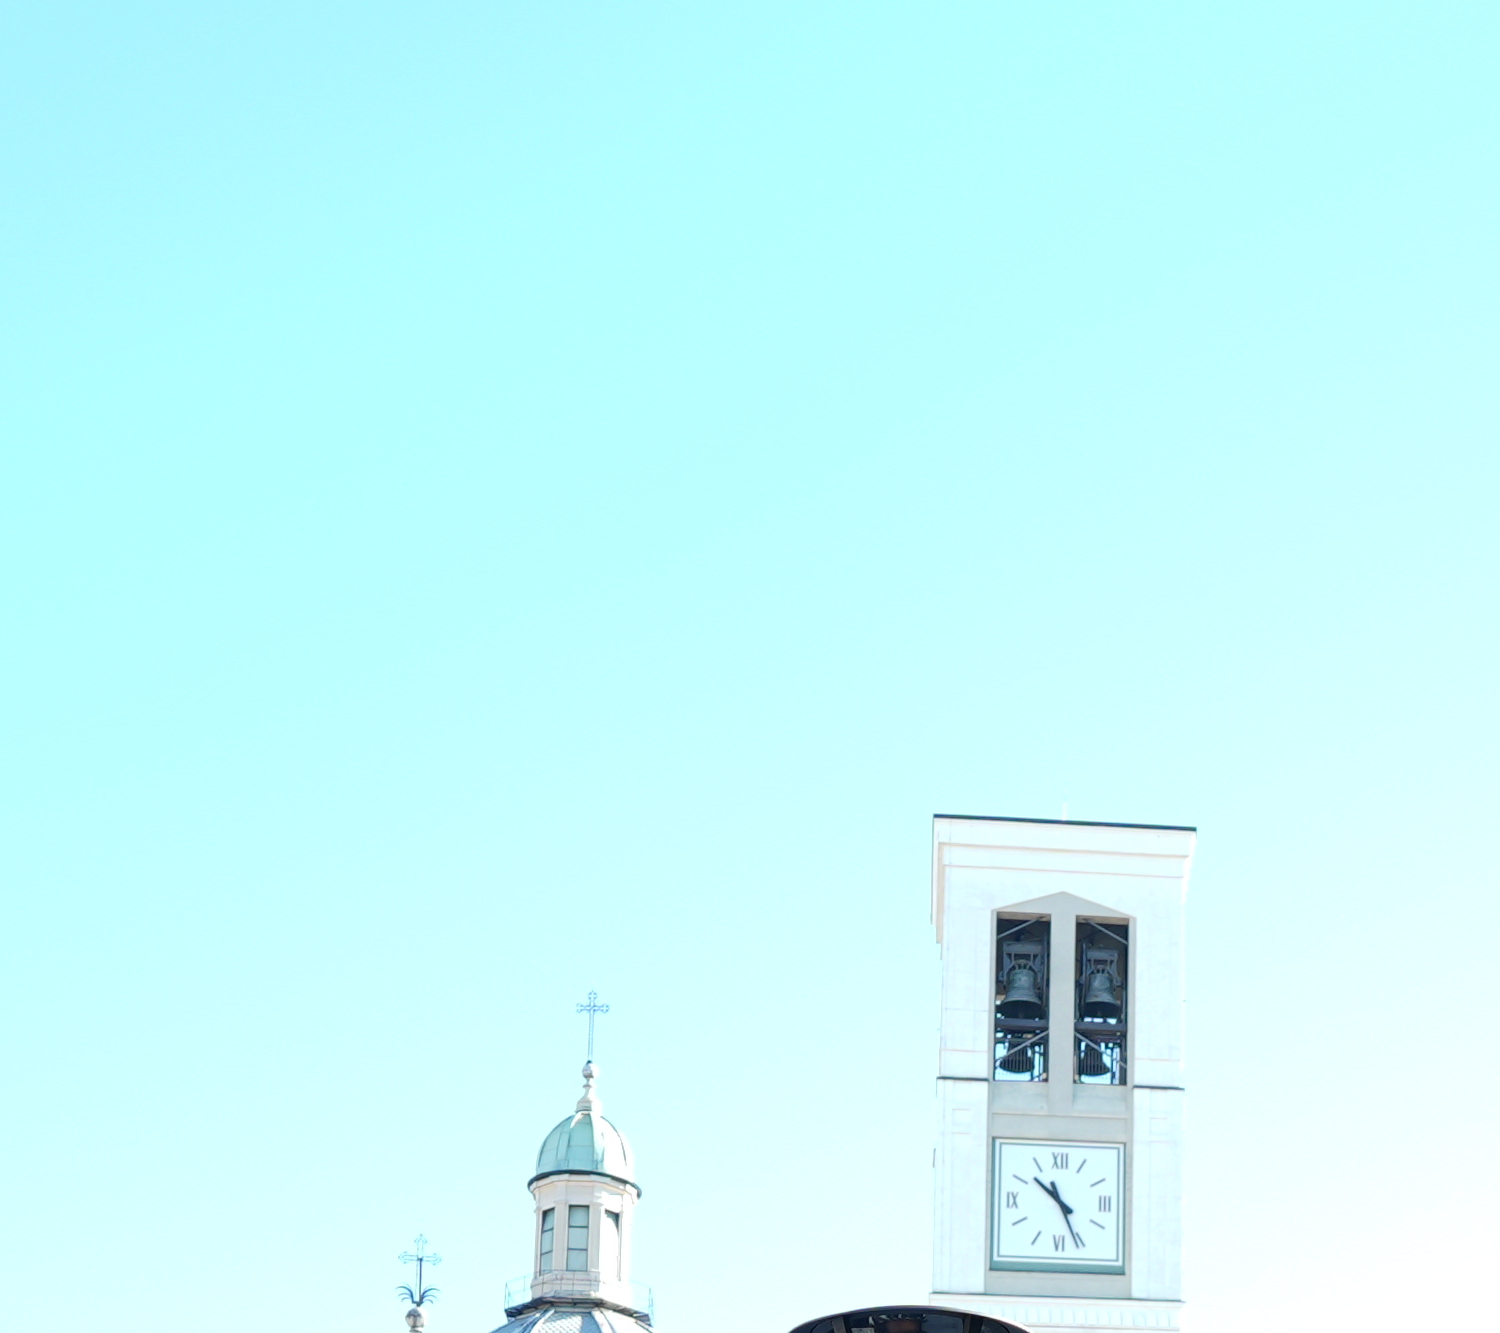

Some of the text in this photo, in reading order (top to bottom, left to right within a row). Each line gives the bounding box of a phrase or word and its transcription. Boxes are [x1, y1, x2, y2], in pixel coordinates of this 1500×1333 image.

[1051, 1152, 1069, 1170] XII
[1006, 1191, 1019, 1209] IX
[1052, 1234, 1066, 1253] VI
